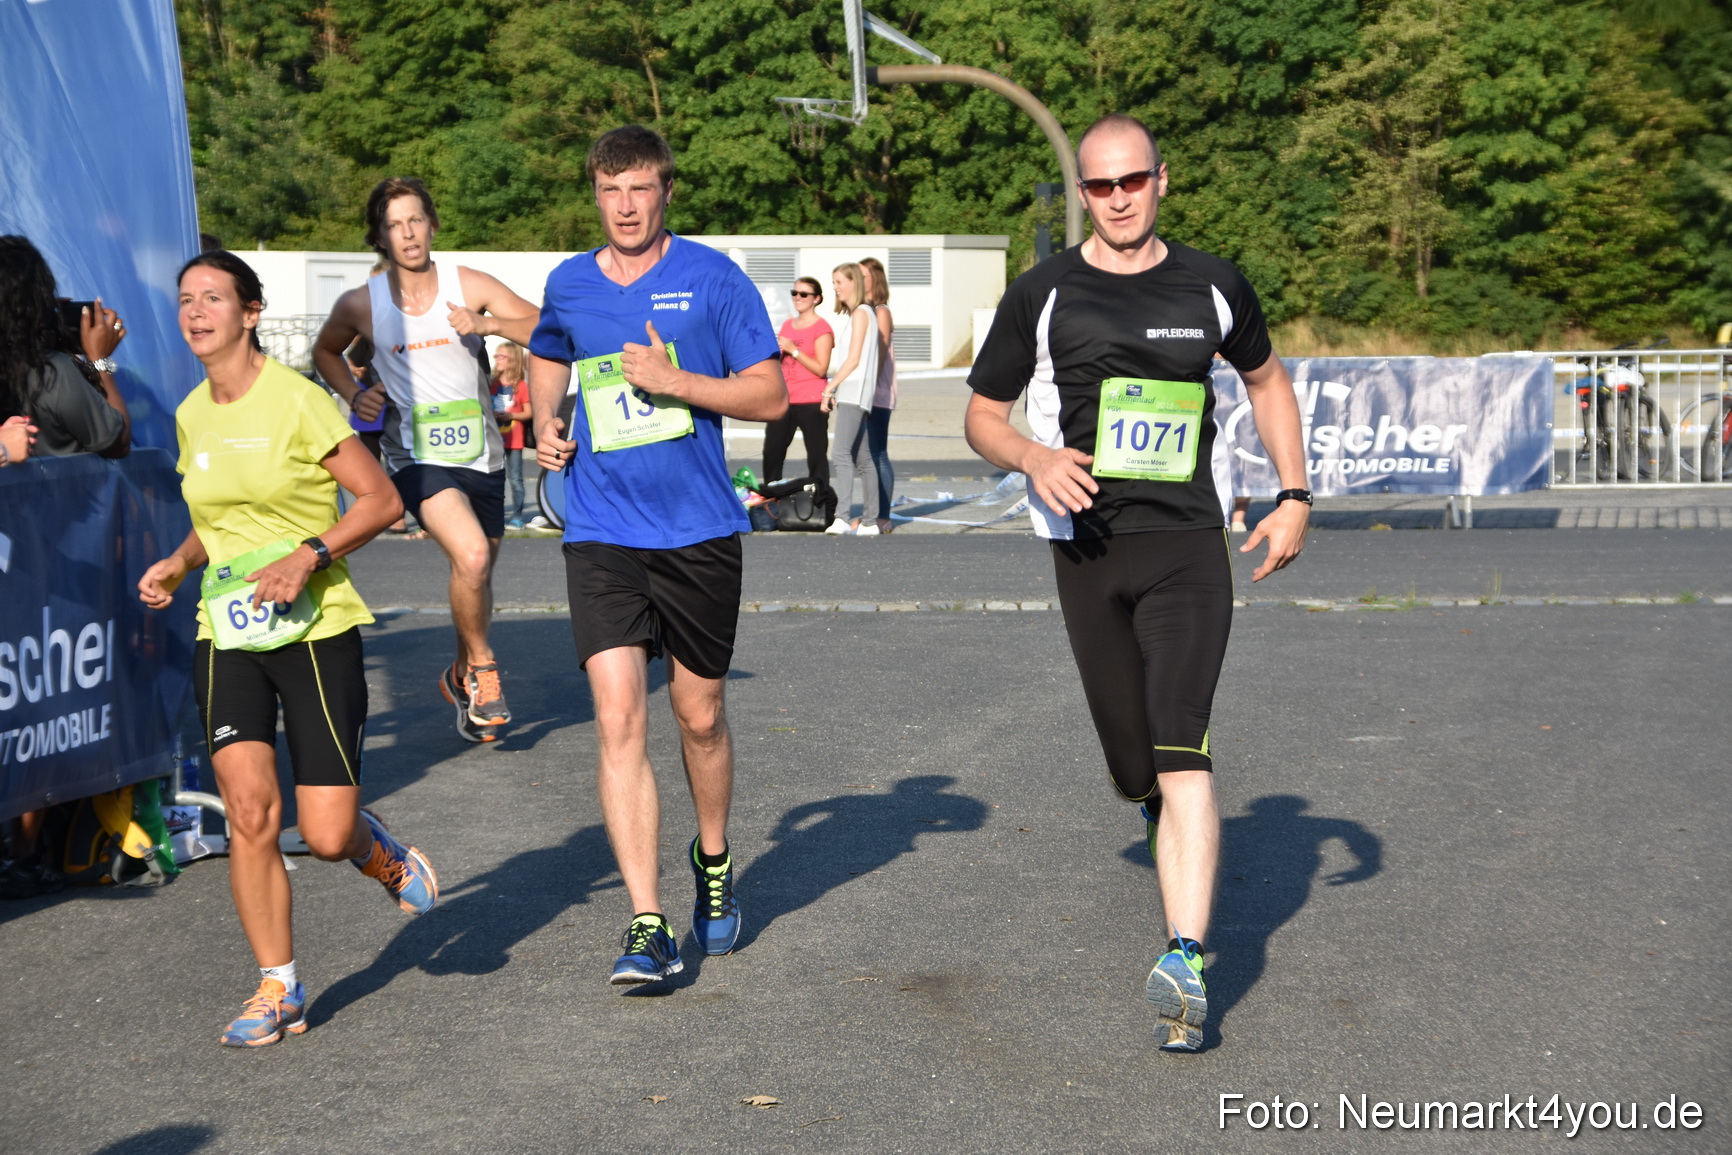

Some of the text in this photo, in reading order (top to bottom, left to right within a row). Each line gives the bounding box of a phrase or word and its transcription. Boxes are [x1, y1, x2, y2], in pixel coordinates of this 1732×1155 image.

[651, 292, 678, 300] Christian
[653, 302, 679, 310] Allianz
[1156, 328, 1205, 338] PFLEIDERER
[615, 388, 655, 420] 13
[1118, 393, 1156, 404] firmenlauf
[429, 425, 470, 446] 589
[618, 427, 637, 435] Eugen
[1110, 418, 1187, 453] 1071
[1126, 457, 1150, 465] Carsten
[1306, 456, 1450, 475] UTOMOBILE
[246, 630, 267, 641] Milena
[0, 703, 112, 765] TOMOBILE
